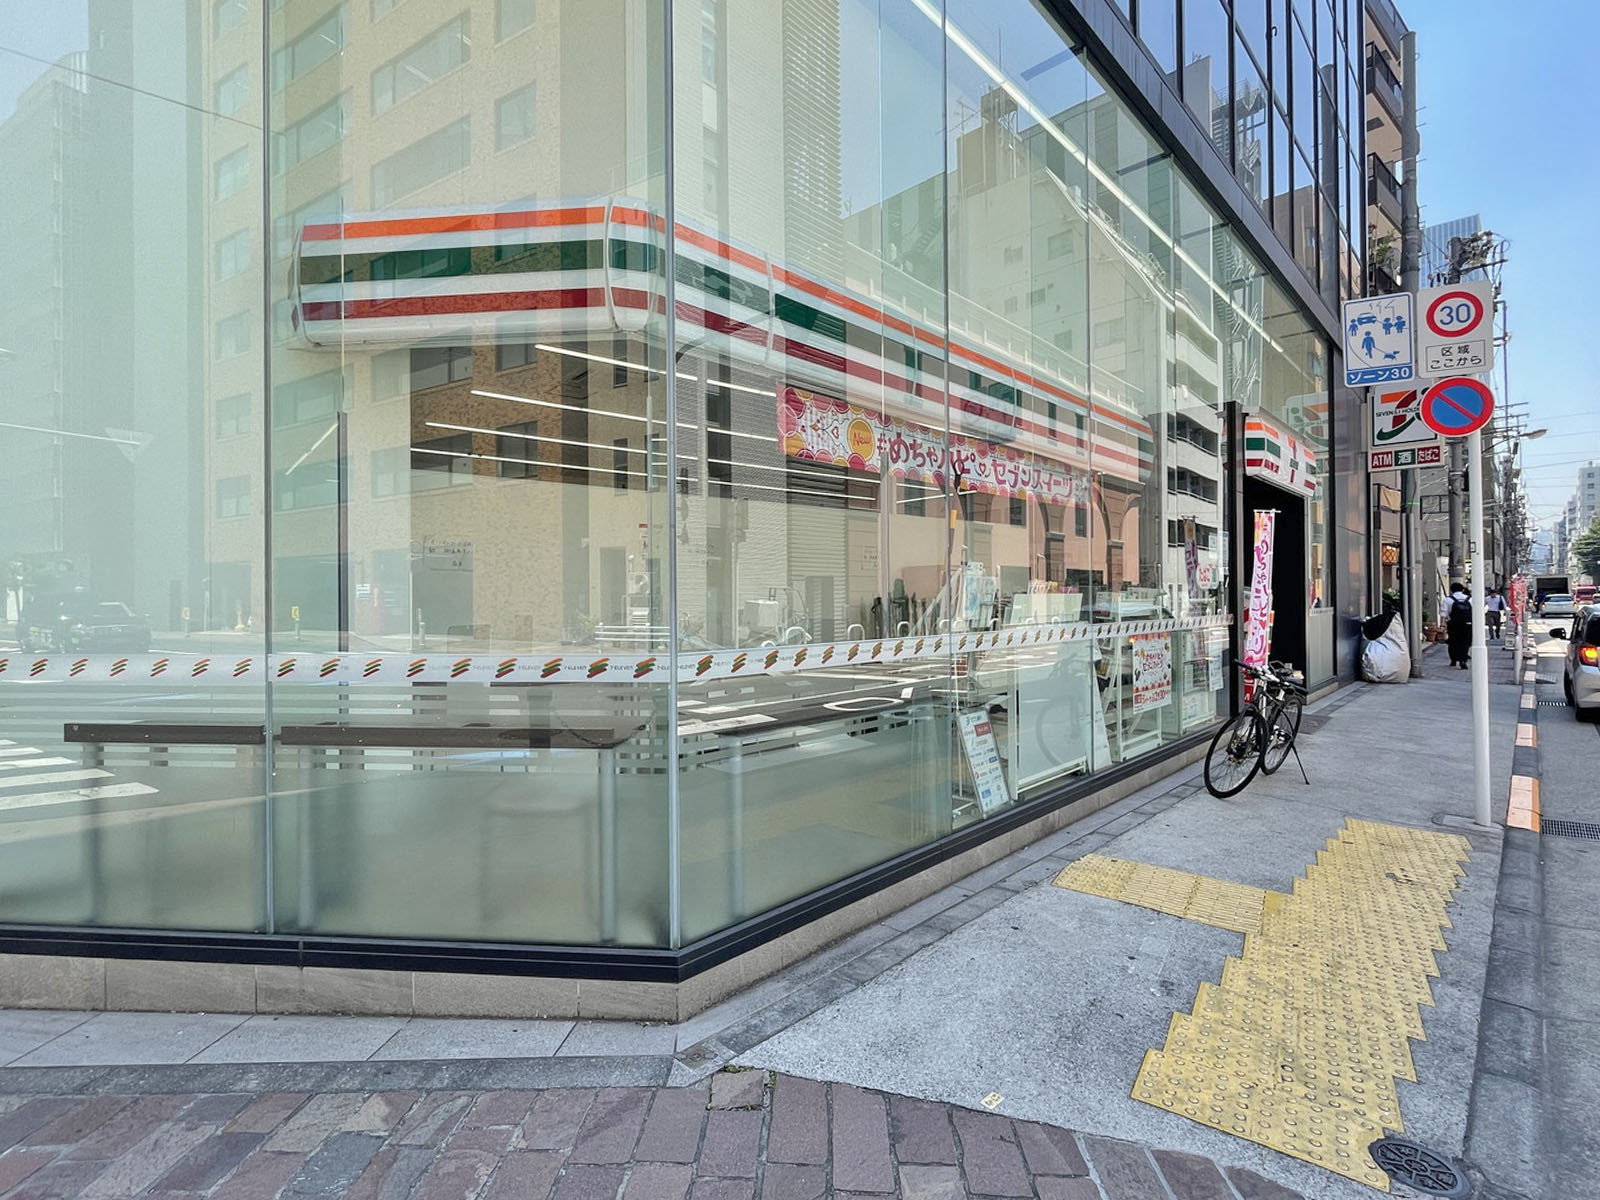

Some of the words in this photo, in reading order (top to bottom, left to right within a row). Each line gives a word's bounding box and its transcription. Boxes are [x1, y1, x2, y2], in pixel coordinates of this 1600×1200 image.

[1440, 303, 1470, 325] 30
[1441, 345, 1470, 357] 区域
[1430, 355, 1482, 370] ここから
[1375, 410, 1394, 418] SEVEN
[1372, 453, 1392, 467] ATM
[1418, 448, 1439, 461] たばこ
[991, 458, 1073, 497] セブンスイーツ
